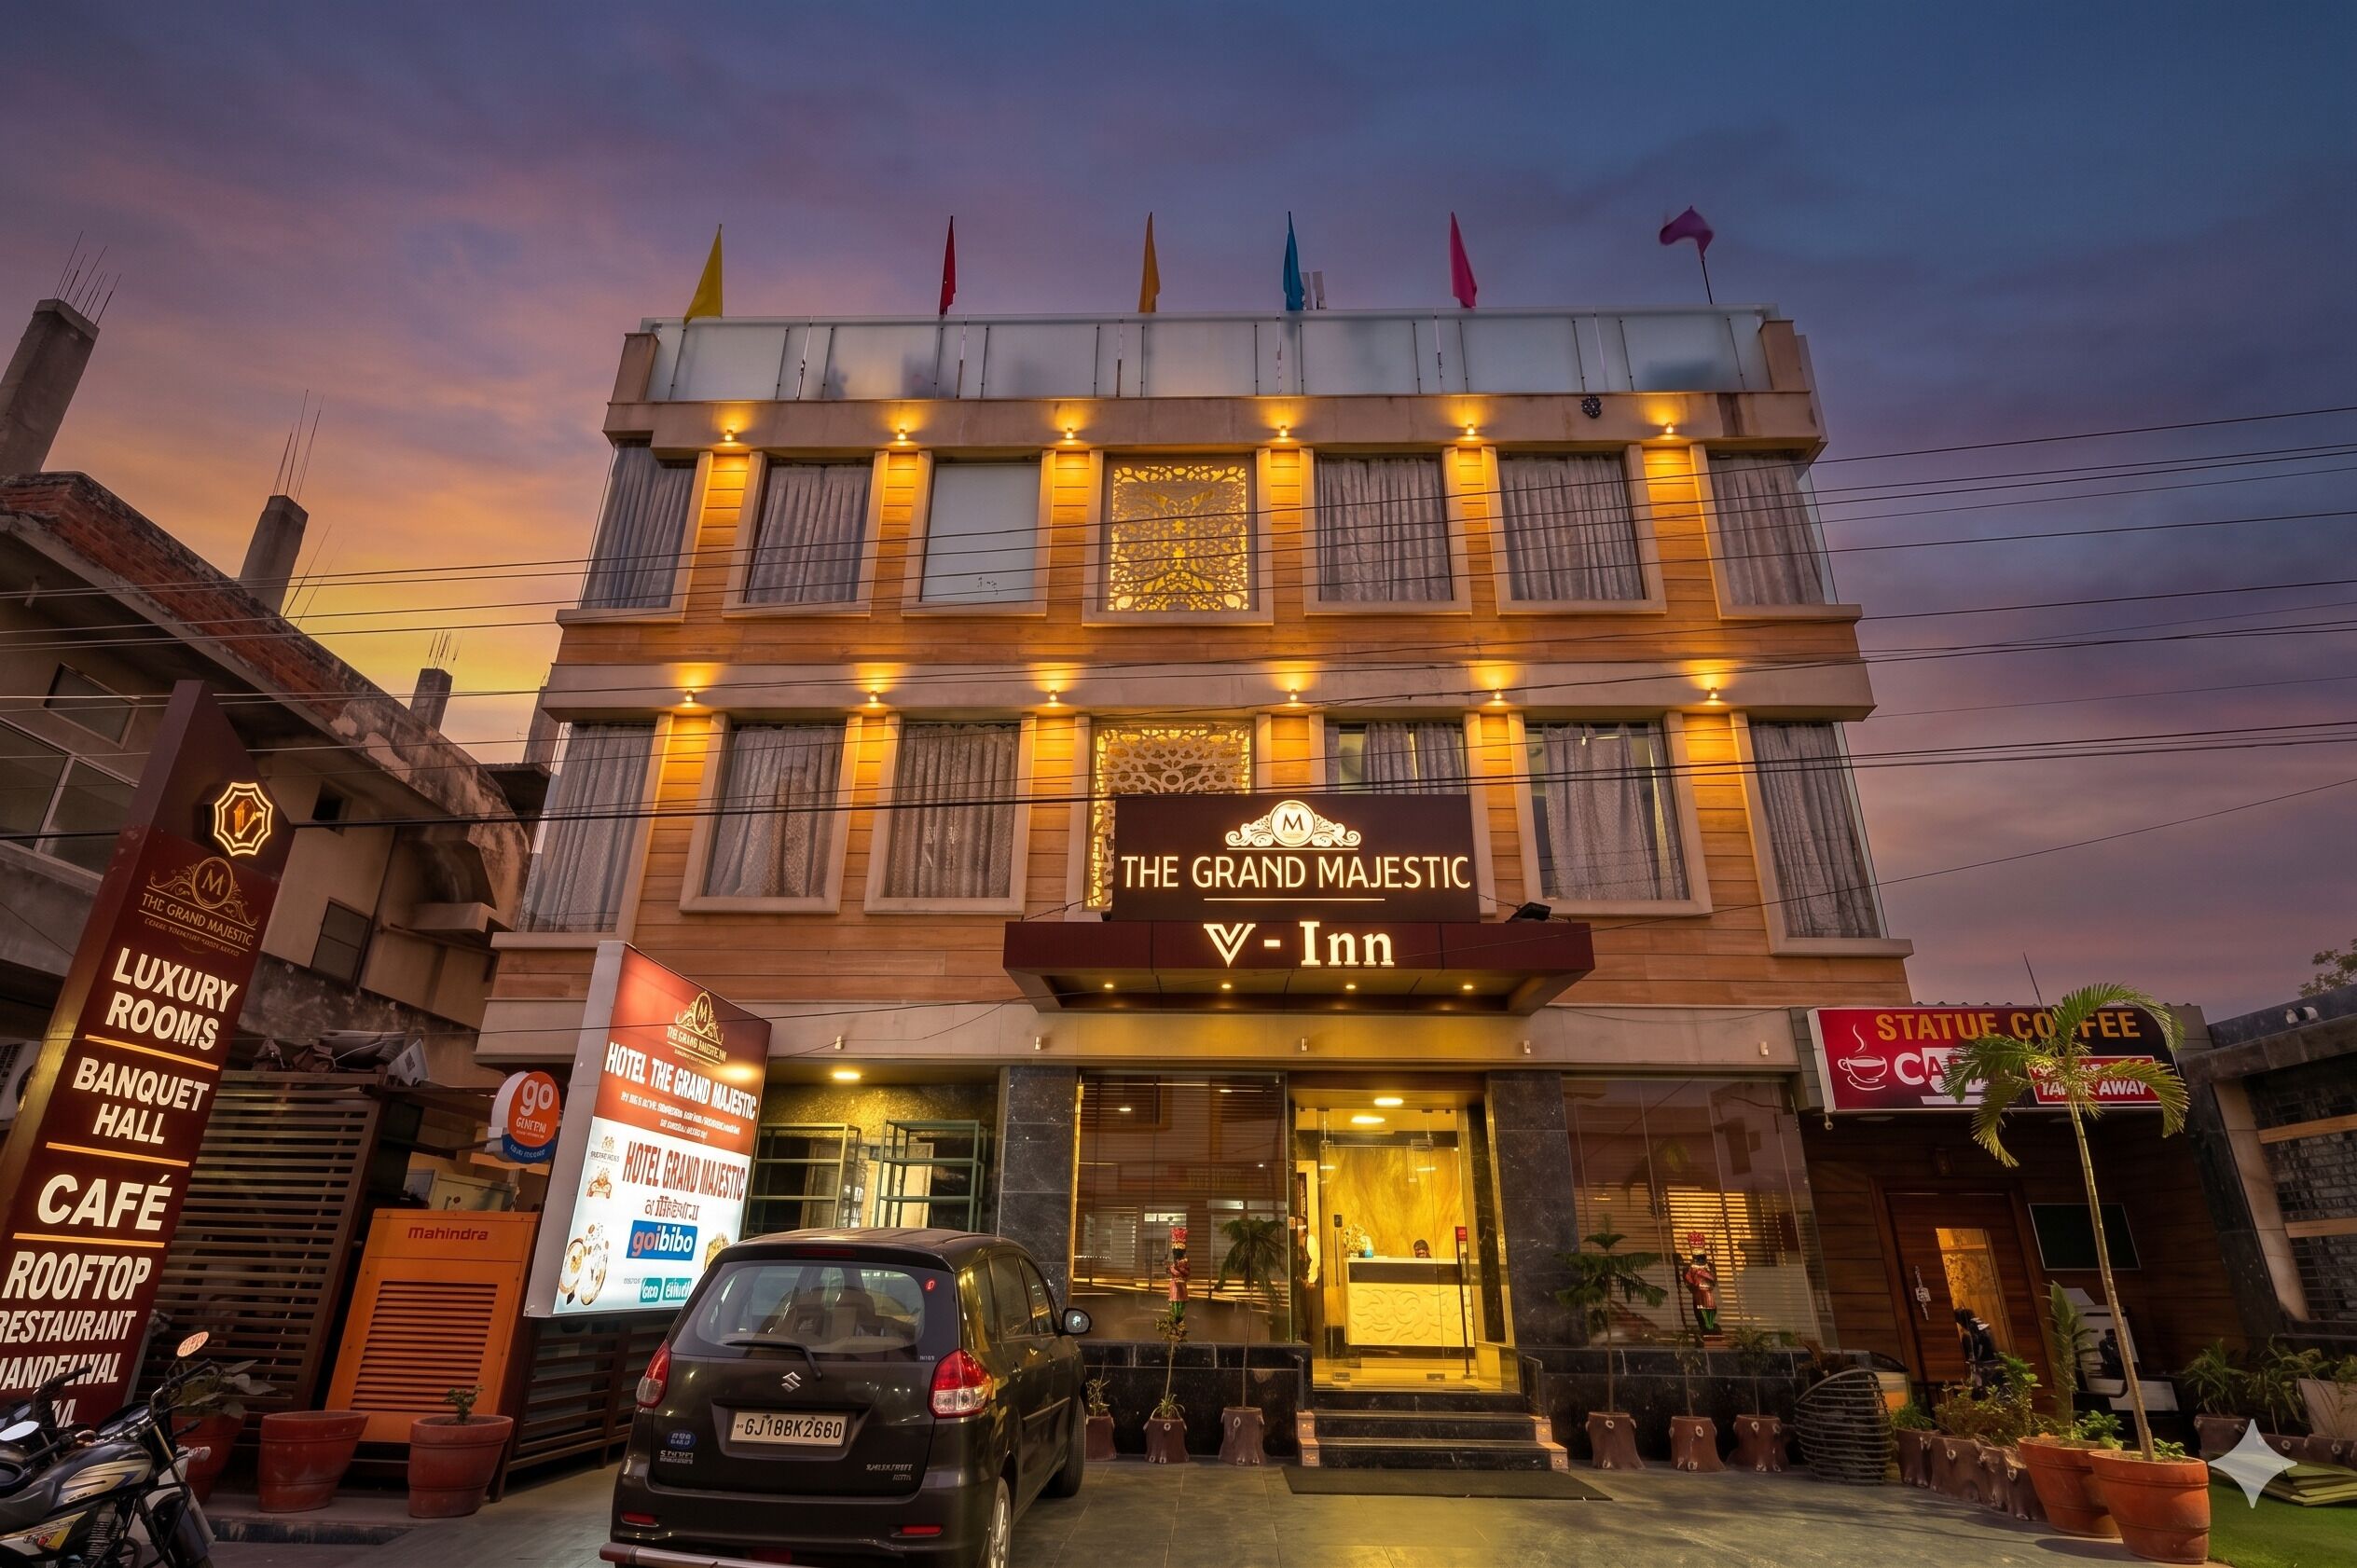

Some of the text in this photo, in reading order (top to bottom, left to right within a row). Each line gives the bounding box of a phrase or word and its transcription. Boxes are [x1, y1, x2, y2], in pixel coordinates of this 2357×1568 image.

[1283, 814, 1303, 831] M
[201, 869, 224, 895] M
[1121, 856, 1471, 888] THE GRAND MAJESTIC
[142, 893, 165, 912] THE
[167, 903, 206, 927] GRAND
[207, 919, 254, 946] MAJESTIC
[1203, 923, 1256, 969] V
[1299, 920, 1395, 968] Inn
[112, 947, 239, 1013] LUXURY
[104, 991, 219, 1051] ROOMS
[1875, 1011, 2142, 1041] STATUE COFEE
[73, 1057, 210, 1111] BANQUET
[519, 1080, 554, 1117] go
[605, 1042, 647, 1084] HOTEL
[650, 1058, 674, 1093] THE
[673, 1067, 711, 1105] GRAND
[711, 1081, 757, 1121] MAJESTIC
[2099, 1080, 2147, 1095] AWAY
[92, 1104, 166, 1145] HALL
[622, 1141, 746, 1202] HOTEL GRAND MAJESTIC
[37, 1175, 172, 1231] CAFÉ
[631, 1225, 693, 1258] goibibo
[1, 1251, 152, 1300] ROOFTOP
[0, 1310, 137, 1343] RESTAURANT
[744, 1418, 842, 1439] GJ18BK2660
